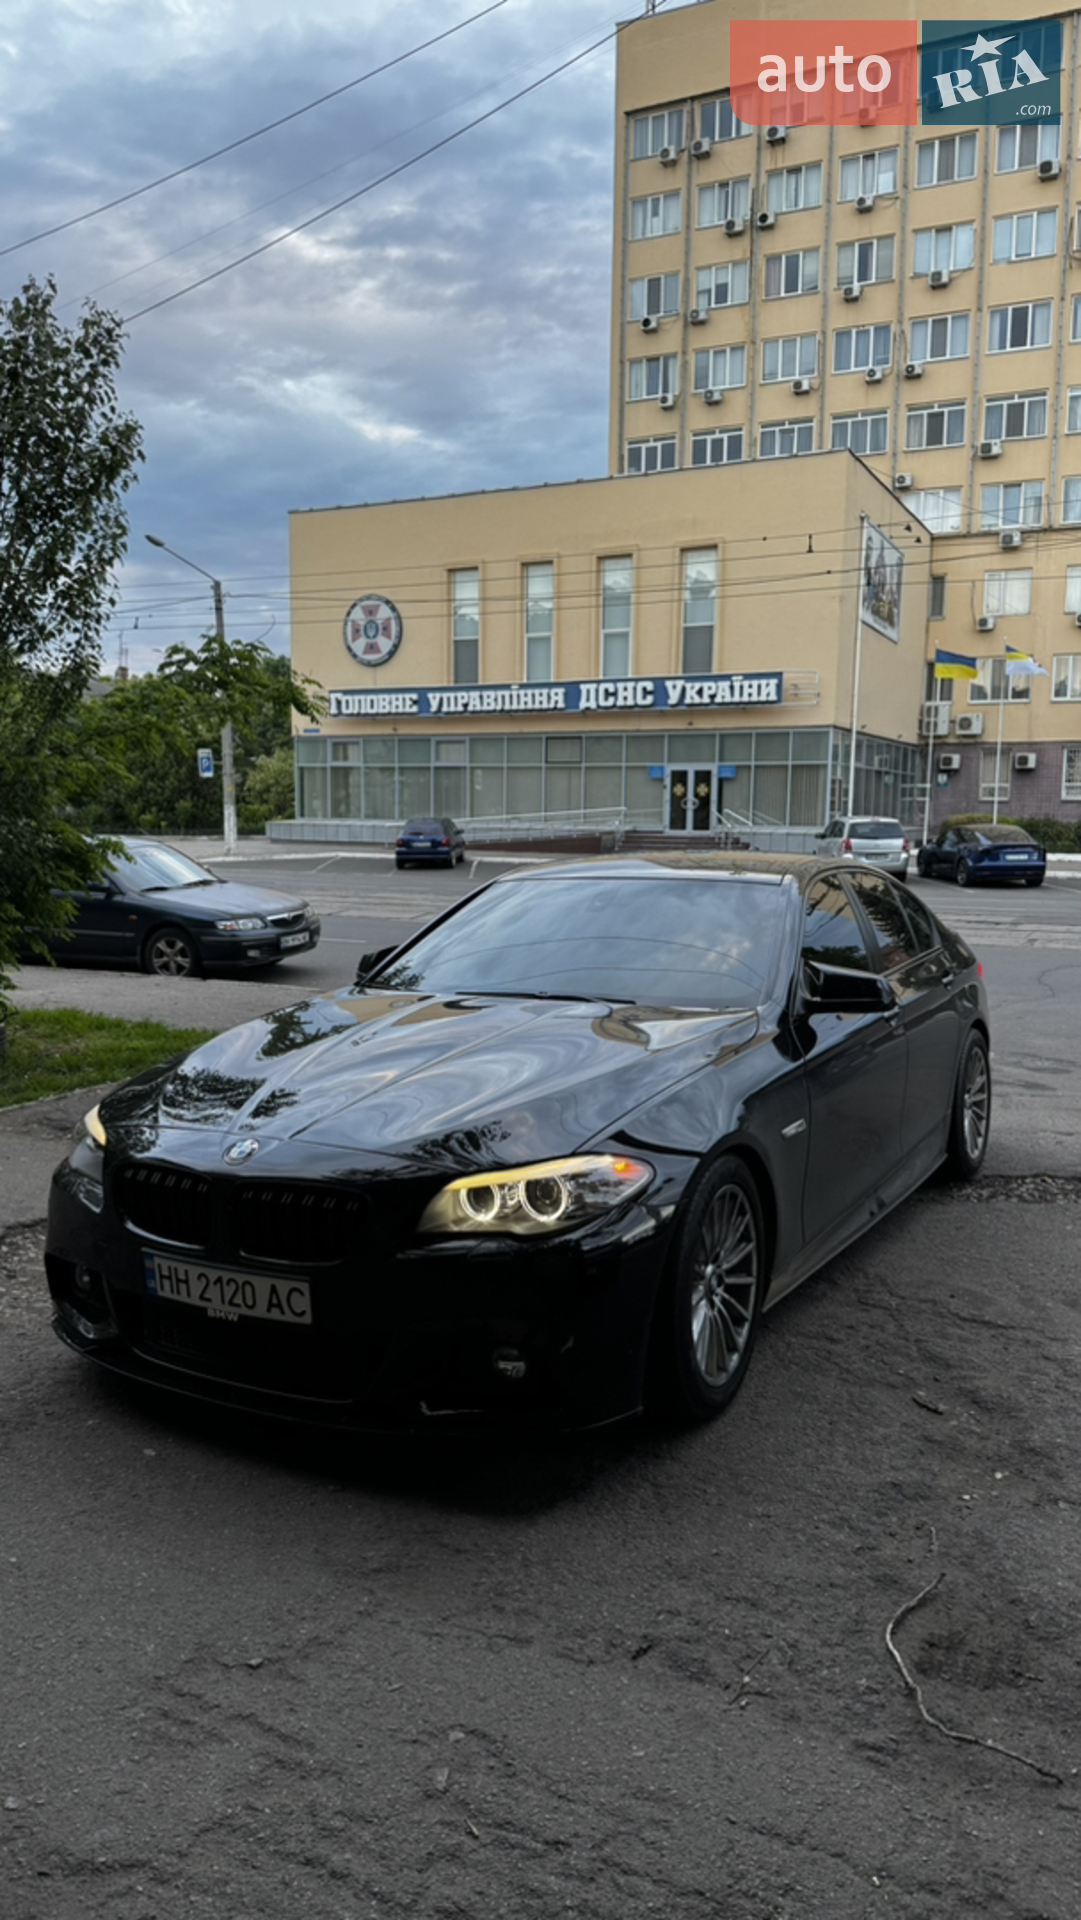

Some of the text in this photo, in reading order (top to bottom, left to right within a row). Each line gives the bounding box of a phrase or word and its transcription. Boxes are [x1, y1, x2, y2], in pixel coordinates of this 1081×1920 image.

[329, 692, 418, 714] ГОЛОВНЕ
[579, 681, 654, 710] ДСНС
[665, 676, 778, 706] УКРАЇНИ
[158, 1264, 306, 1317] HH 2120 AC
